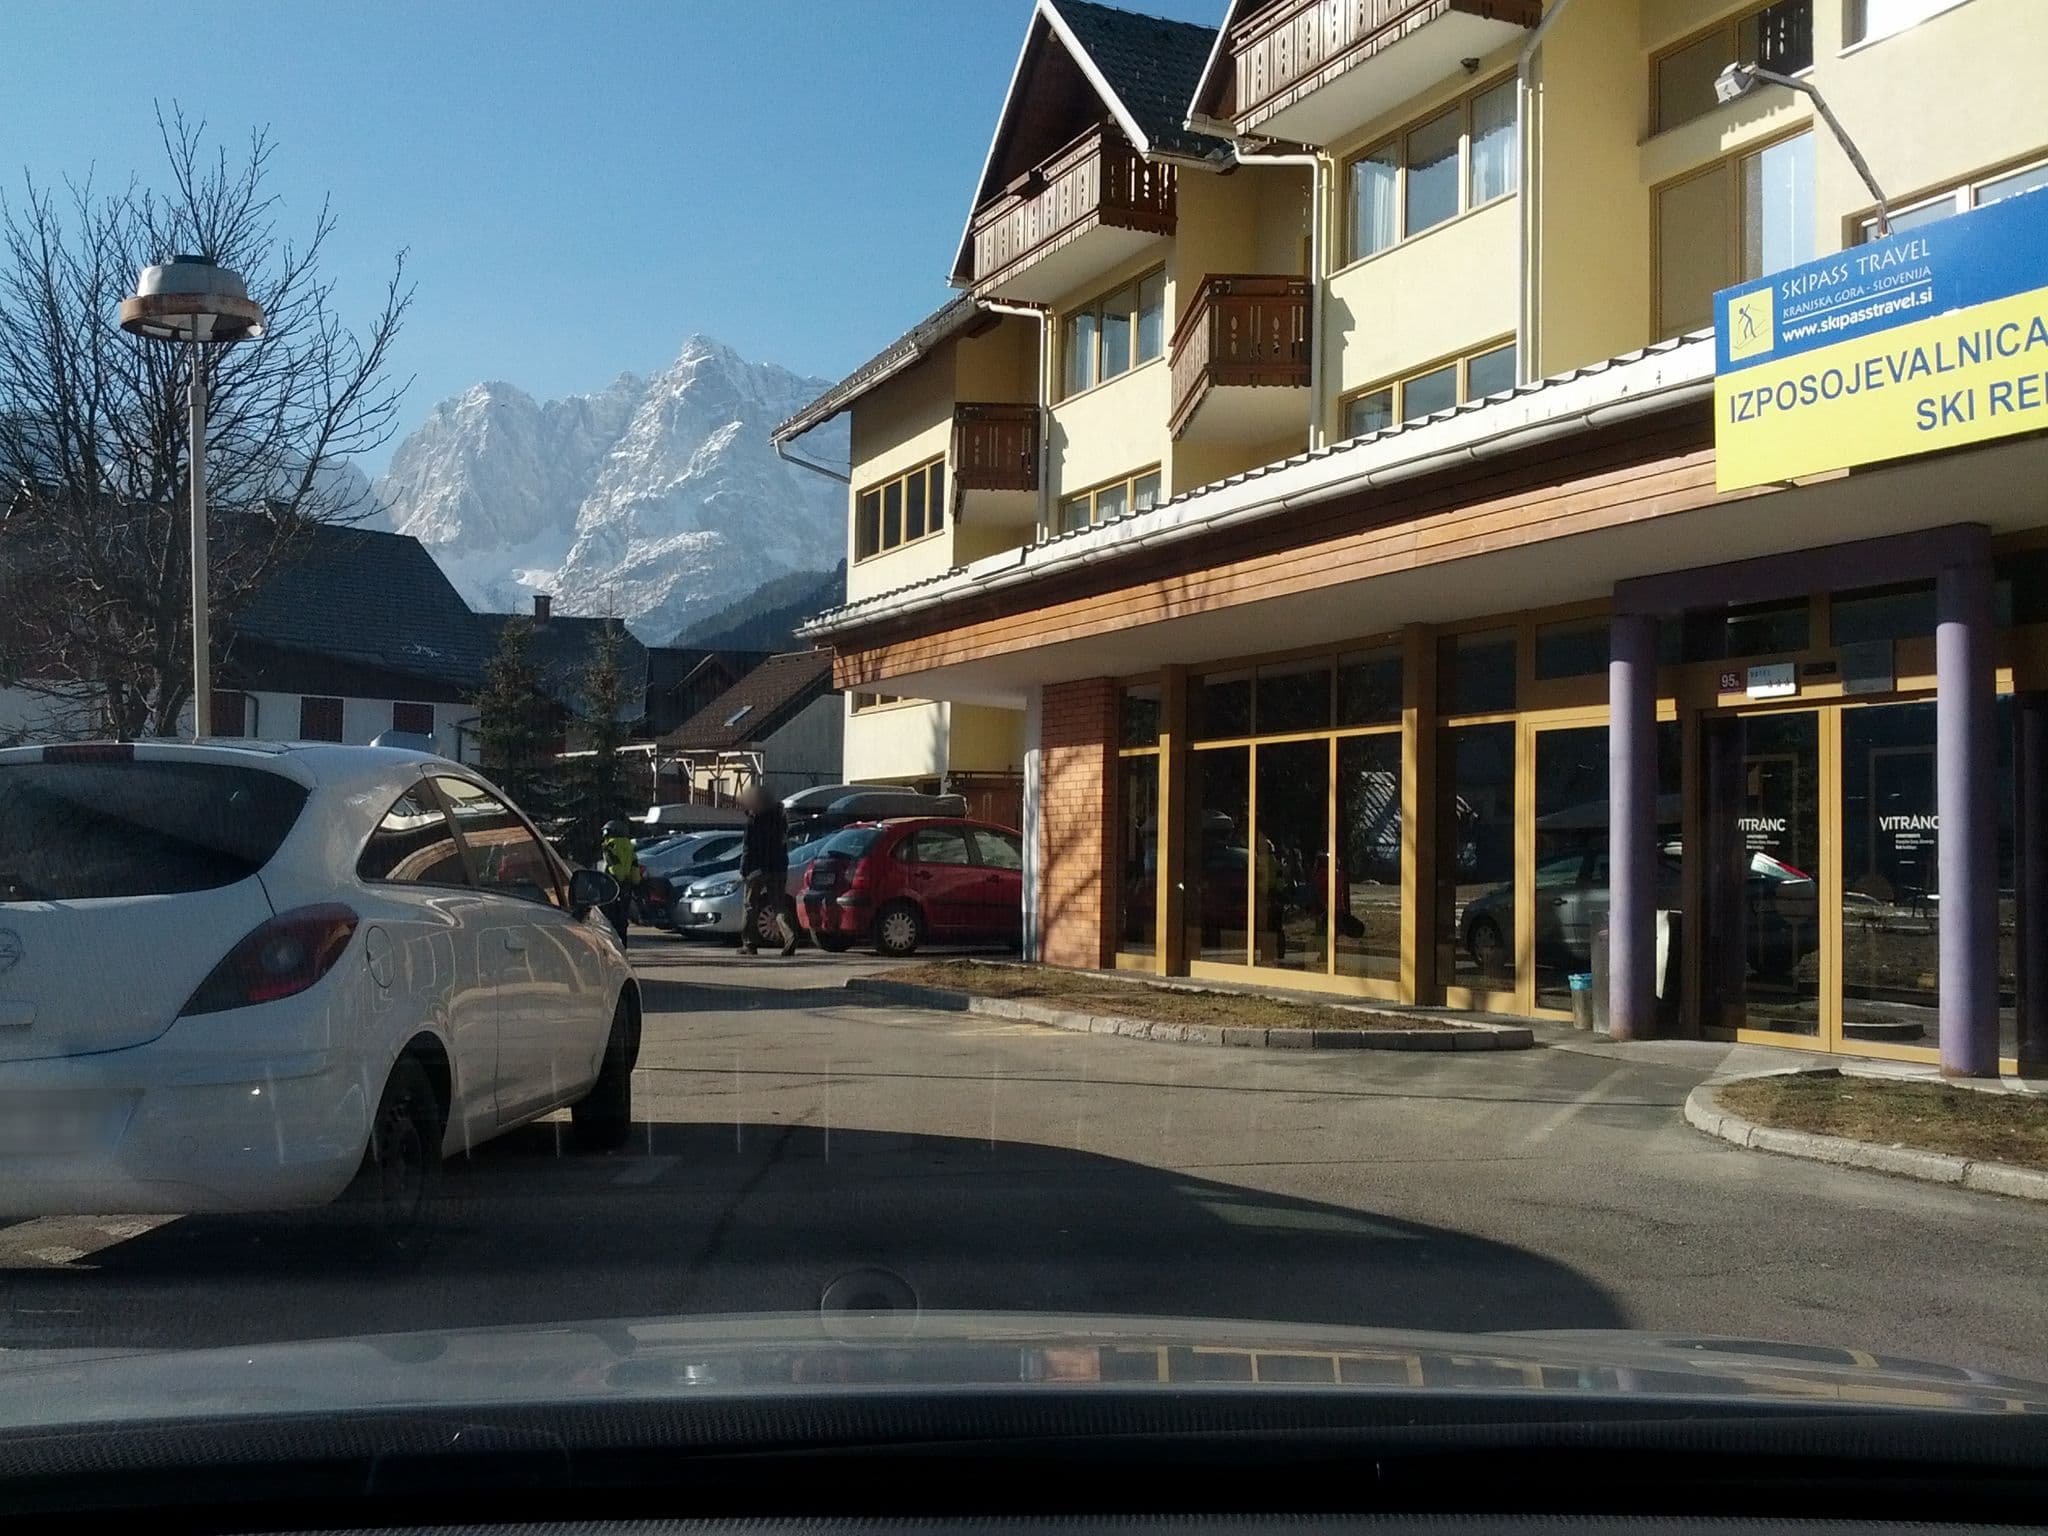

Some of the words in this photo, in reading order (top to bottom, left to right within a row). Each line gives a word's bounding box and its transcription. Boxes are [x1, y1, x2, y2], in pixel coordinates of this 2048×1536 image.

[1782, 263, 1848, 300] SKIPASS
[1856, 238, 1931, 276] TRAVEL
[1783, 295, 1833, 319] KRANJSKA
[1834, 285, 1865, 304] GORA
[1873, 265, 1931, 291] SLOVENIJA
[1782, 286, 1933, 343] www.skipasstravel.si
[1730, 315, 2048, 424] IZPOSOJEVALNICA
[1916, 388, 1975, 431] SKI
[1989, 370, 2048, 416] RE
[1879, 814, 1940, 831] VITRANC
